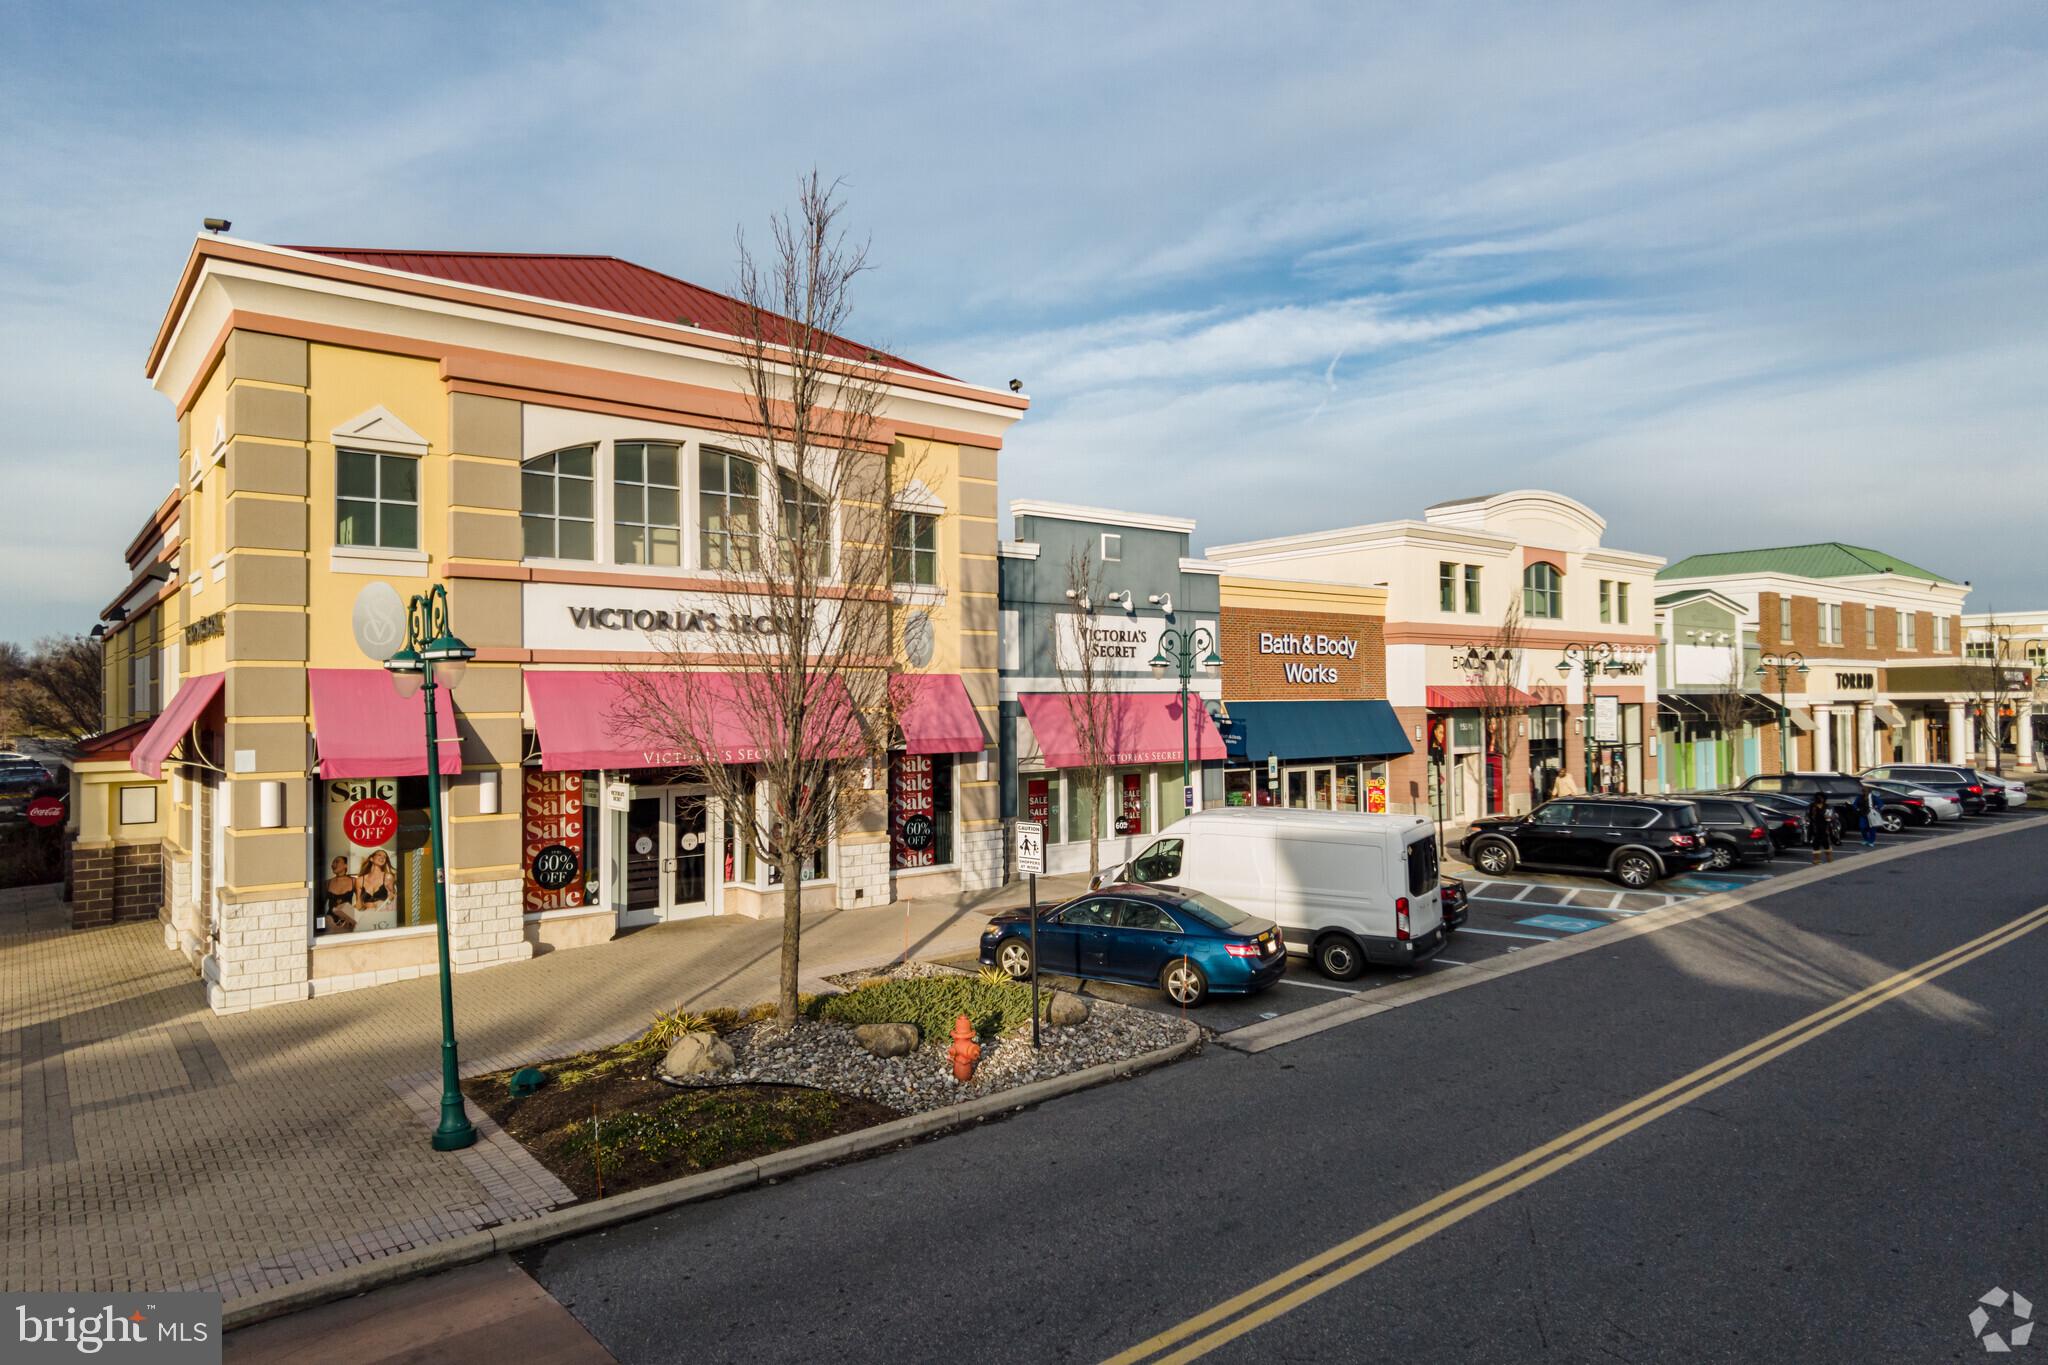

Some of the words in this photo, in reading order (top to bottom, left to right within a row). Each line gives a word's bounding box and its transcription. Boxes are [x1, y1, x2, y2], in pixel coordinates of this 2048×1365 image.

[568, 606, 719, 633] VICTORIA'S
[729, 613, 811, 635] SECR
[1079, 627, 1147, 643] VICTORIA'S
[1092, 643, 1137, 658] SECRET
[1259, 632, 1300, 655] Bath
[1301, 634, 1316, 655] &
[1315, 634, 1358, 660] Body
[1283, 662, 1338, 684] Works
[1835, 672, 1873, 690] TORRID
[895, 755, 931, 772] Sale
[1104, 752, 1149, 763] CTORIA'S
[1151, 751, 1182, 761] SECRET
[330, 778, 394, 803] Sale
[526, 771, 580, 793] Sale
[895, 773, 932, 791] Sale
[895, 792, 932, 811] Sale
[1029, 797, 1048, 805] SALE
[1124, 789, 1140, 797] SALE
[526, 793, 580, 817] Sale
[1029, 807, 1048, 816] SALE
[350, 808, 393, 828] 60%
[353, 827, 386, 840] OFF
[526, 816, 580, 840] Sale
[906, 822, 931, 835] 60%
[907, 836, 927, 845] OFF
[538, 854, 574, 871] 60%
[896, 850, 932, 868] Sale
[539, 871, 567, 883] OFF
[526, 887, 580, 911] Sale
